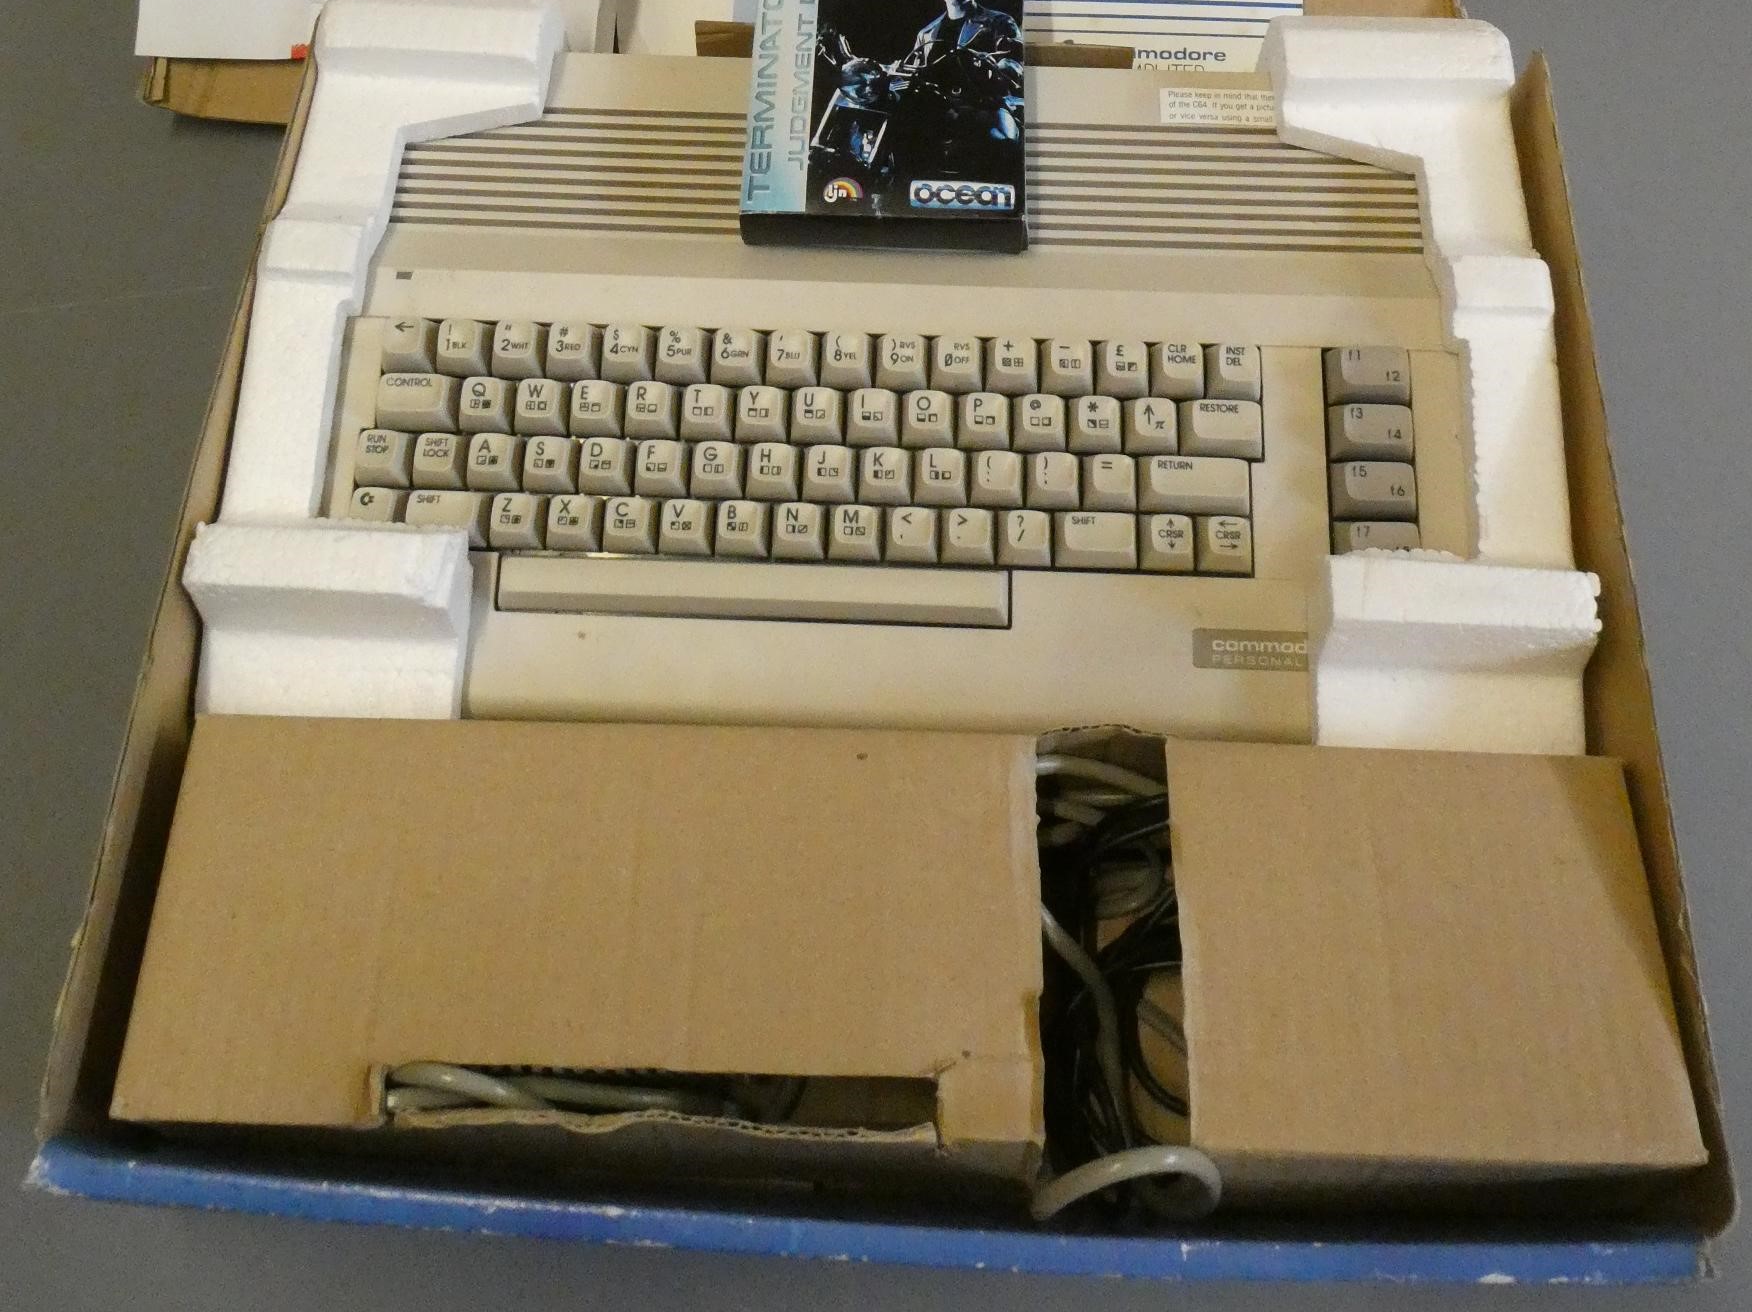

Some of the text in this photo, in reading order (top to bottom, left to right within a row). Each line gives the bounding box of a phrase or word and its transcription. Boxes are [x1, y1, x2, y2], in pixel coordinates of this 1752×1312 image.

[787, 13, 815, 172] JUDGMENT
[1220, 103, 1234, 112] you
[1236, 103, 1247, 112] get
[1180, 112, 1195, 120] vice
[914, 182, 1012, 207] ocean
[559, 326, 569, 337] #
[612, 328, 620, 341] $
[669, 330, 682, 343] %
[722, 333, 733, 345] &
[610, 342, 620, 355] 4
[666, 345, 676, 358] 5
[720, 347, 730, 359] 6
[953, 342, 970, 351] RVS
[1115, 344, 1125, 356] £
[1168, 343, 1187, 353] CLR
[1225, 346, 1245, 355] INST
[777, 349, 784, 361] 7
[833, 349, 843, 362] 8
[890, 352, 899, 366] 9
[1167, 355, 1197, 365] HOME
[1225, 356, 1242, 366] DEL
[386, 376, 433, 388] CONTROL
[472, 383, 486, 396] Q
[527, 384, 544, 398] W
[580, 386, 589, 400] E
[636, 387, 647, 400] R
[693, 390, 701, 403] T
[749, 391, 760, 405] Y
[804, 392, 814, 407] U
[916, 396, 931, 412] O
[973, 398, 983, 412] P
[1029, 399, 1042, 411] @
[1199, 403, 1239, 414] RESTORE
[367, 434, 387, 444] RUN
[425, 437, 449, 448] SHIFT
[365, 444, 389, 454] STOP
[422, 448, 450, 458] LOCK
[478, 440, 492, 453] A
[535, 441, 545, 455] S
[591, 444, 603, 457] D
[647, 445, 655, 458] F
[704, 446, 717, 461] G
[760, 448, 772, 463] H
[817, 451, 826, 465] J
[874, 453, 883, 467] K
[930, 454, 938, 468] L
[1101, 461, 1113, 469] =
[1157, 460, 1193, 471] RETURN
[416, 493, 441, 504] SHIFT
[502, 498, 512, 512] Z
[560, 499, 572, 514] X
[615, 502, 629, 518] C
[673, 504, 685, 518] V
[727, 505, 737, 519] B
[786, 508, 799, 522] N
[842, 510, 860, 524] M
[901, 512, 912, 524] <
[957, 513, 968, 526] >
[1017, 515, 1025, 528] ?
[1071, 516, 1096, 526] SHIFT
[1017, 529, 1025, 542] /
[1158, 529, 1184, 539] CRSR
[1215, 531, 1241, 540] CRSR
